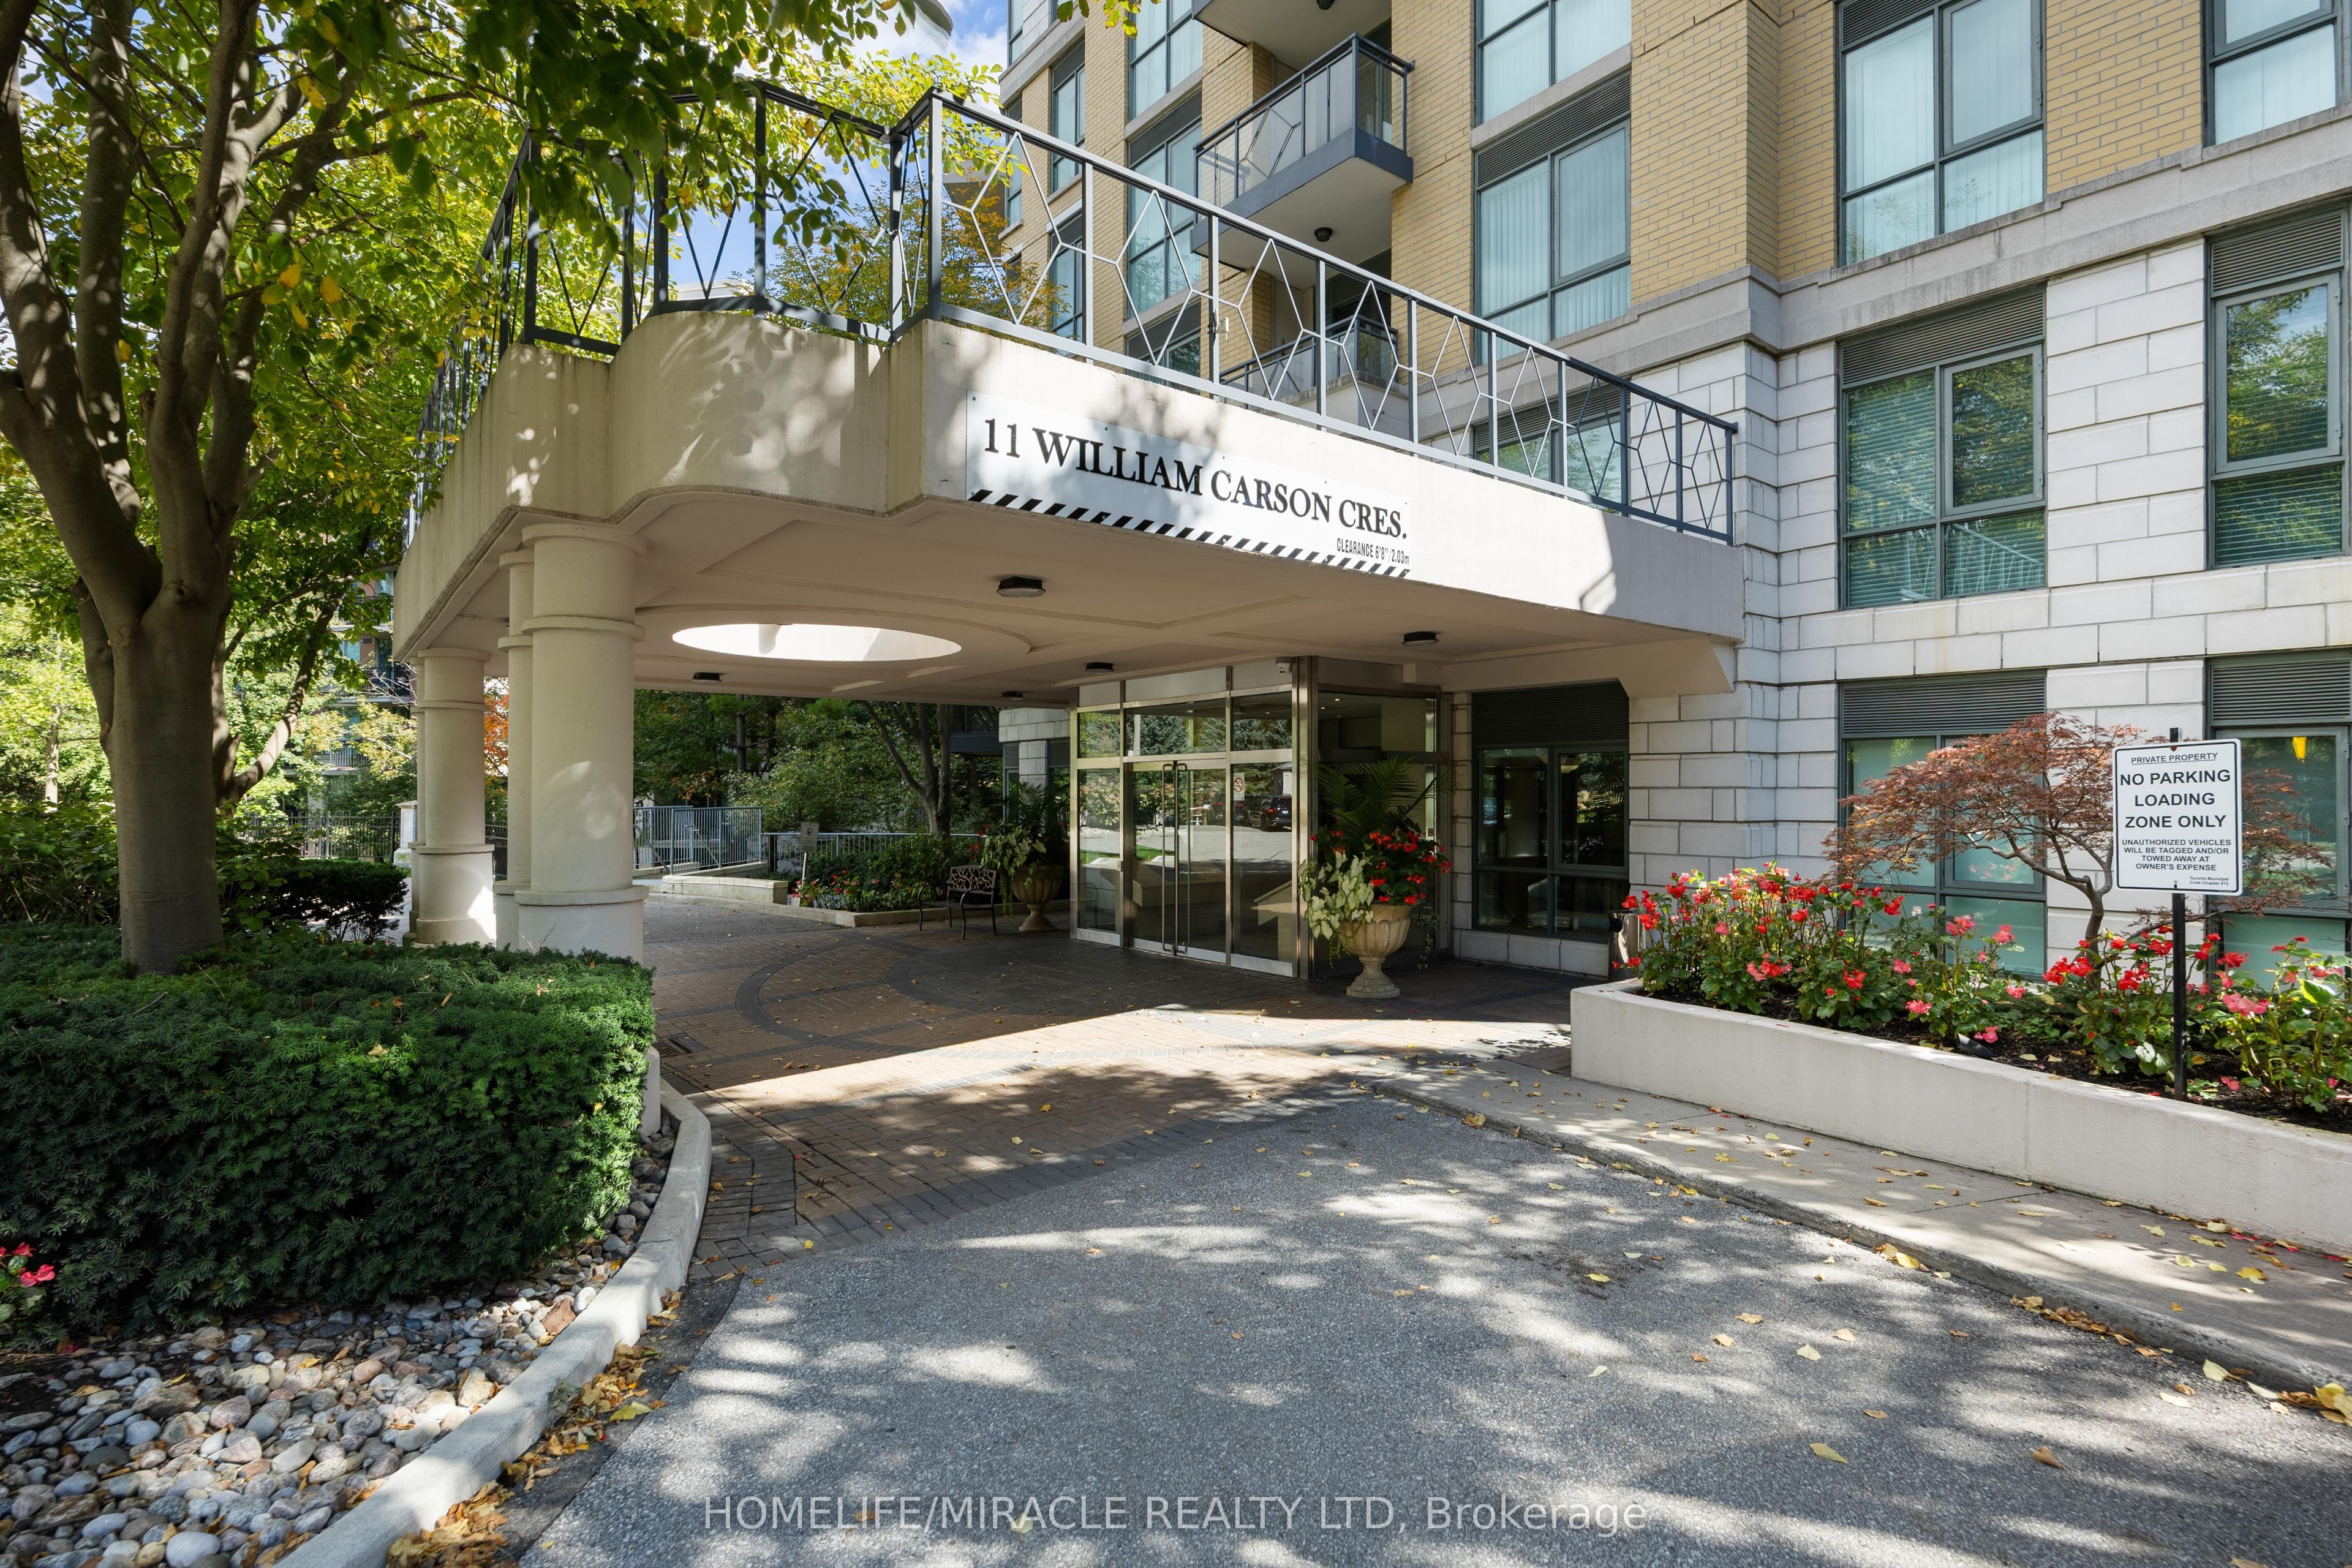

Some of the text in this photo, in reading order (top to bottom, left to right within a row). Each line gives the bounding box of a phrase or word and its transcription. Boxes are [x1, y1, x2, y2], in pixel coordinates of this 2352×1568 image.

[984, 418, 1408, 540] 11 WILLIAM CARSON CRES.
[1336, 537, 1374, 558] CLEARANCE
[2132, 752, 2218, 764] PRIVATE PROPERTY
[2120, 769, 2231, 786] NO PARKING
[2135, 792, 2215, 807] LOADING
[2125, 815, 2227, 828] ZONE ONLY
